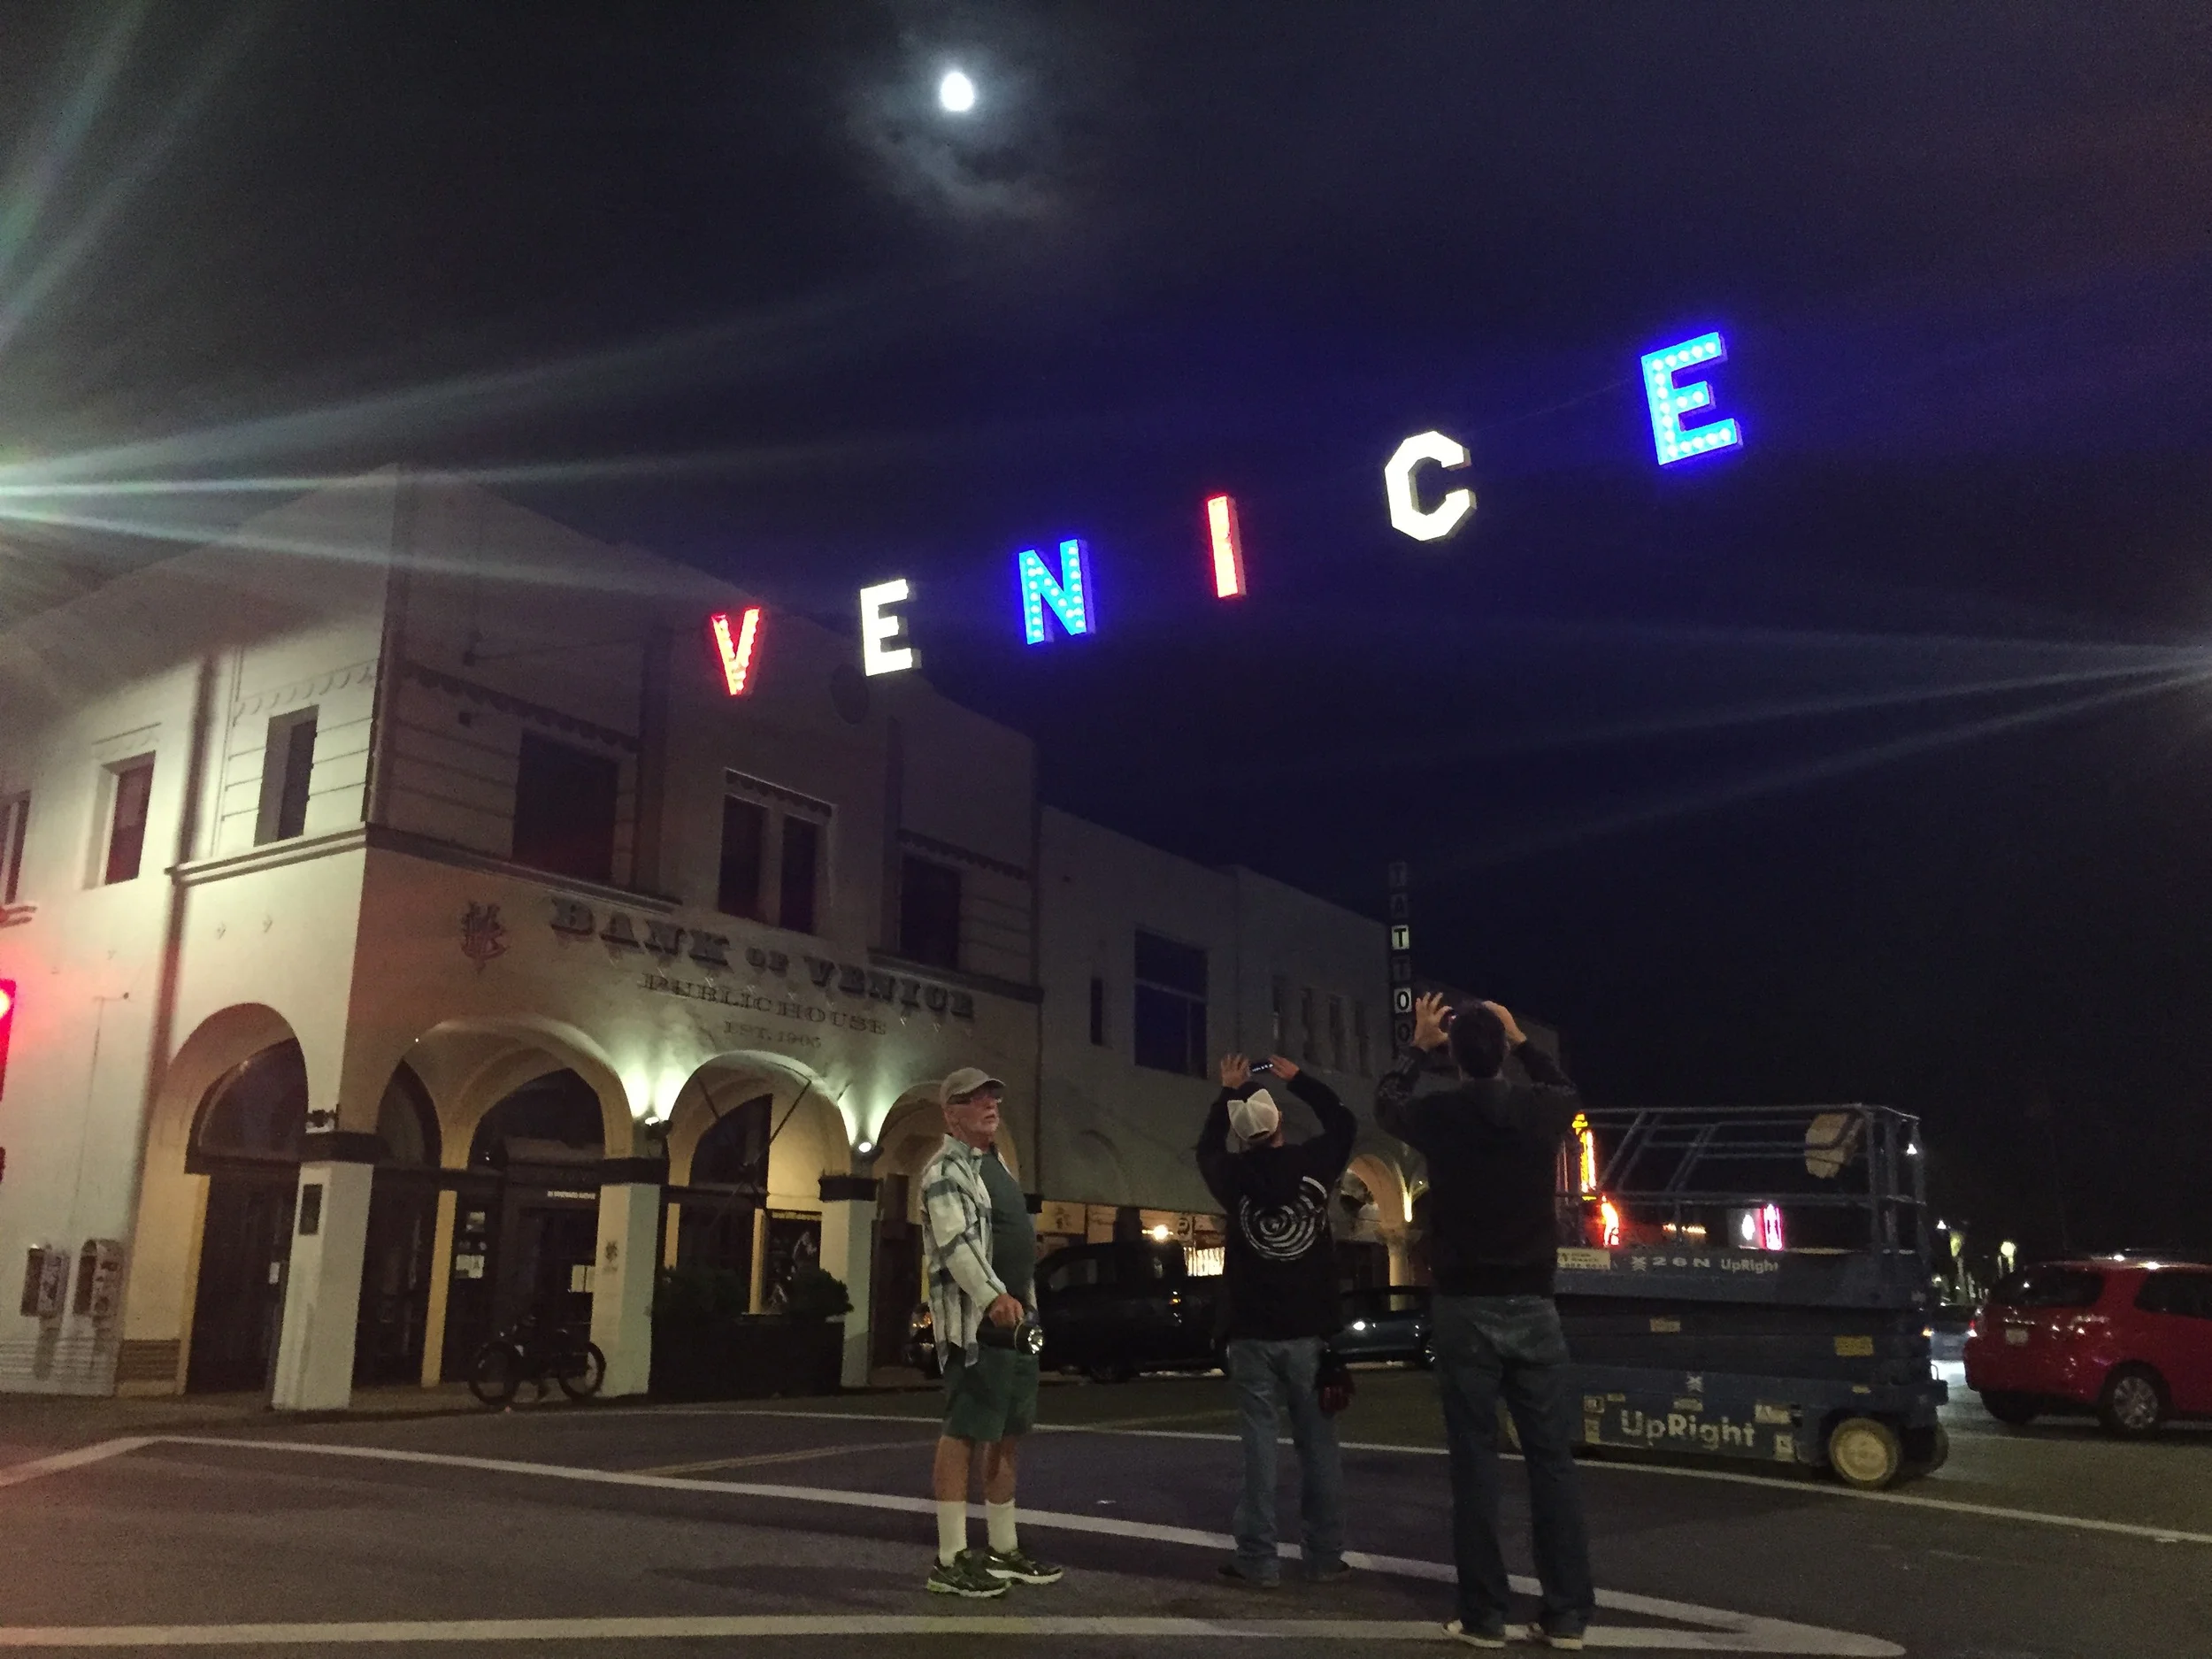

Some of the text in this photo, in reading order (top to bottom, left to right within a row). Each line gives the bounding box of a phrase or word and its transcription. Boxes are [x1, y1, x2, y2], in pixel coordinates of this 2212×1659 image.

[711, 332, 1743, 697] VENICE
[550, 896, 974, 1018] BANK OF VENICE
[1390, 864, 1411, 1044] TATTOO
[637, 972, 886, 1035] PUBLIC HOUSE
[1720, 1257, 1779, 1274] UpRight
[1620, 1408, 1755, 1452] UpRight
